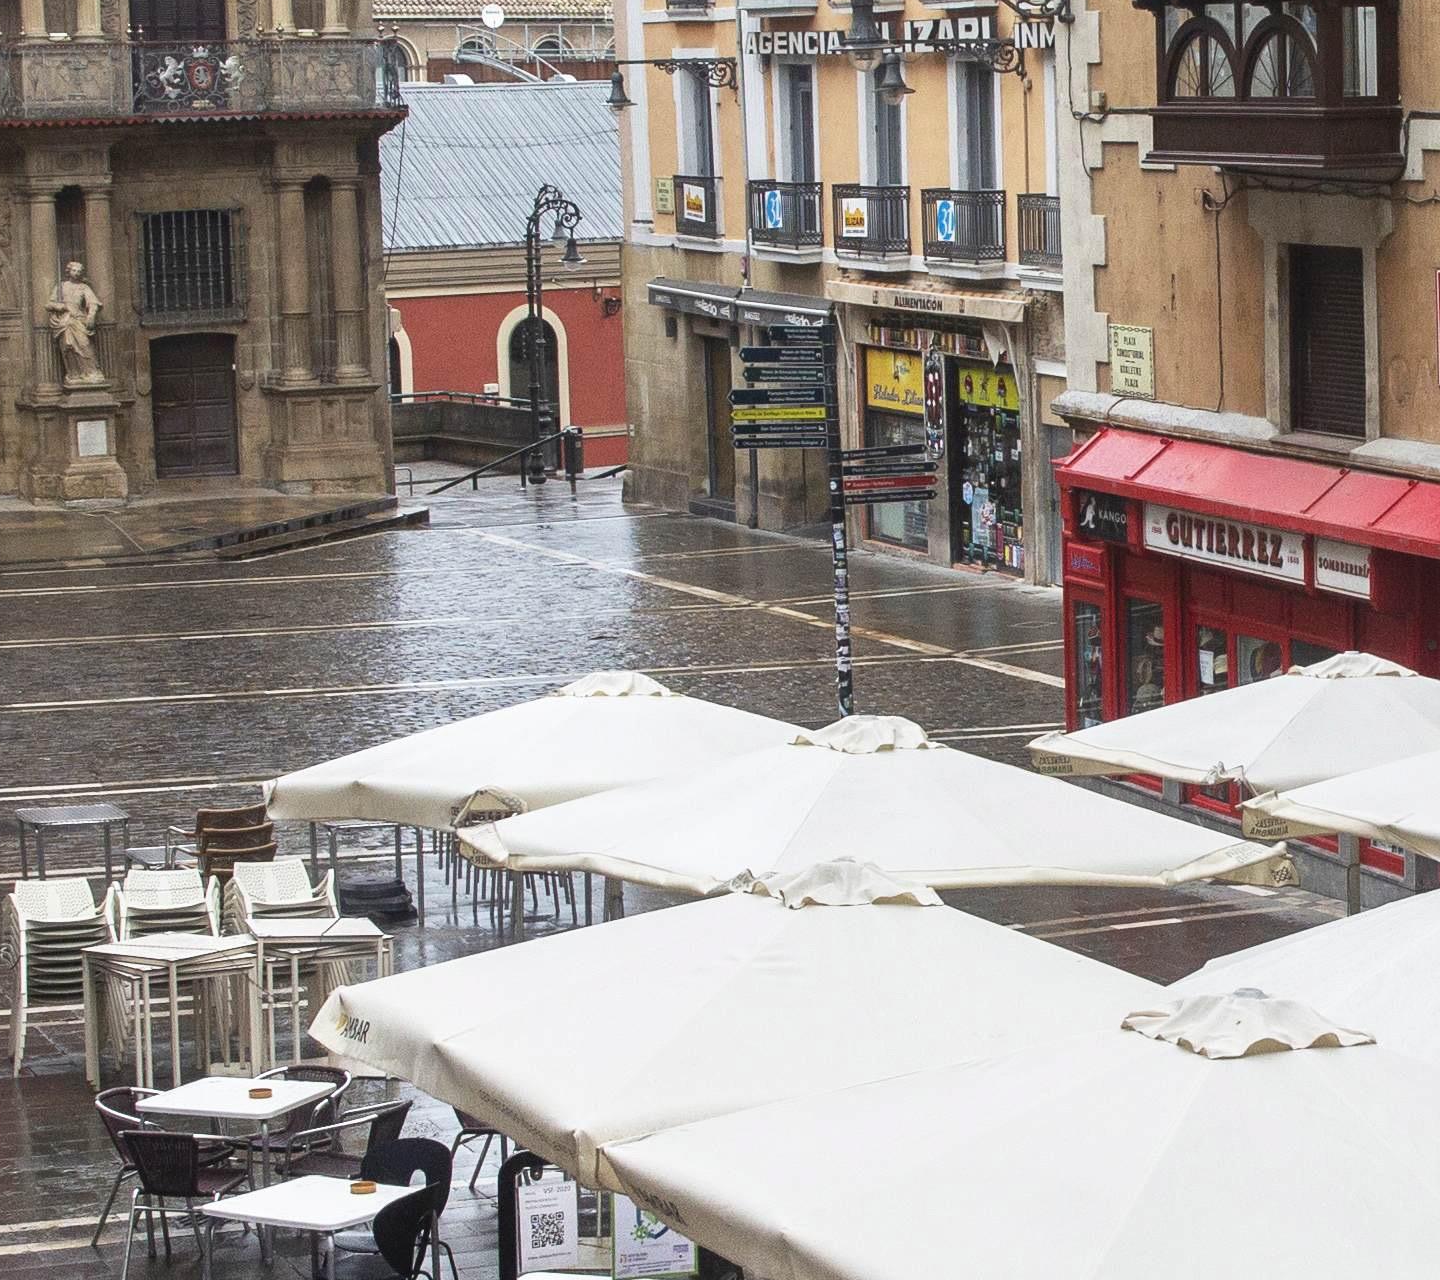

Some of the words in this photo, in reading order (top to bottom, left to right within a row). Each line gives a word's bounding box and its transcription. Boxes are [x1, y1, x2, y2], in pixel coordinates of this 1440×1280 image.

[746, 32, 842, 55] AGENCIA
[875, 16, 991, 53] LIZARI
[893, 294, 944, 311] ALIMENTACIÓN
[1099, 509, 1127, 524] KANGO
[1165, 510, 1283, 568] GUTIERREZ
[1318, 556, 1369, 578] SOMBRERERÍ
